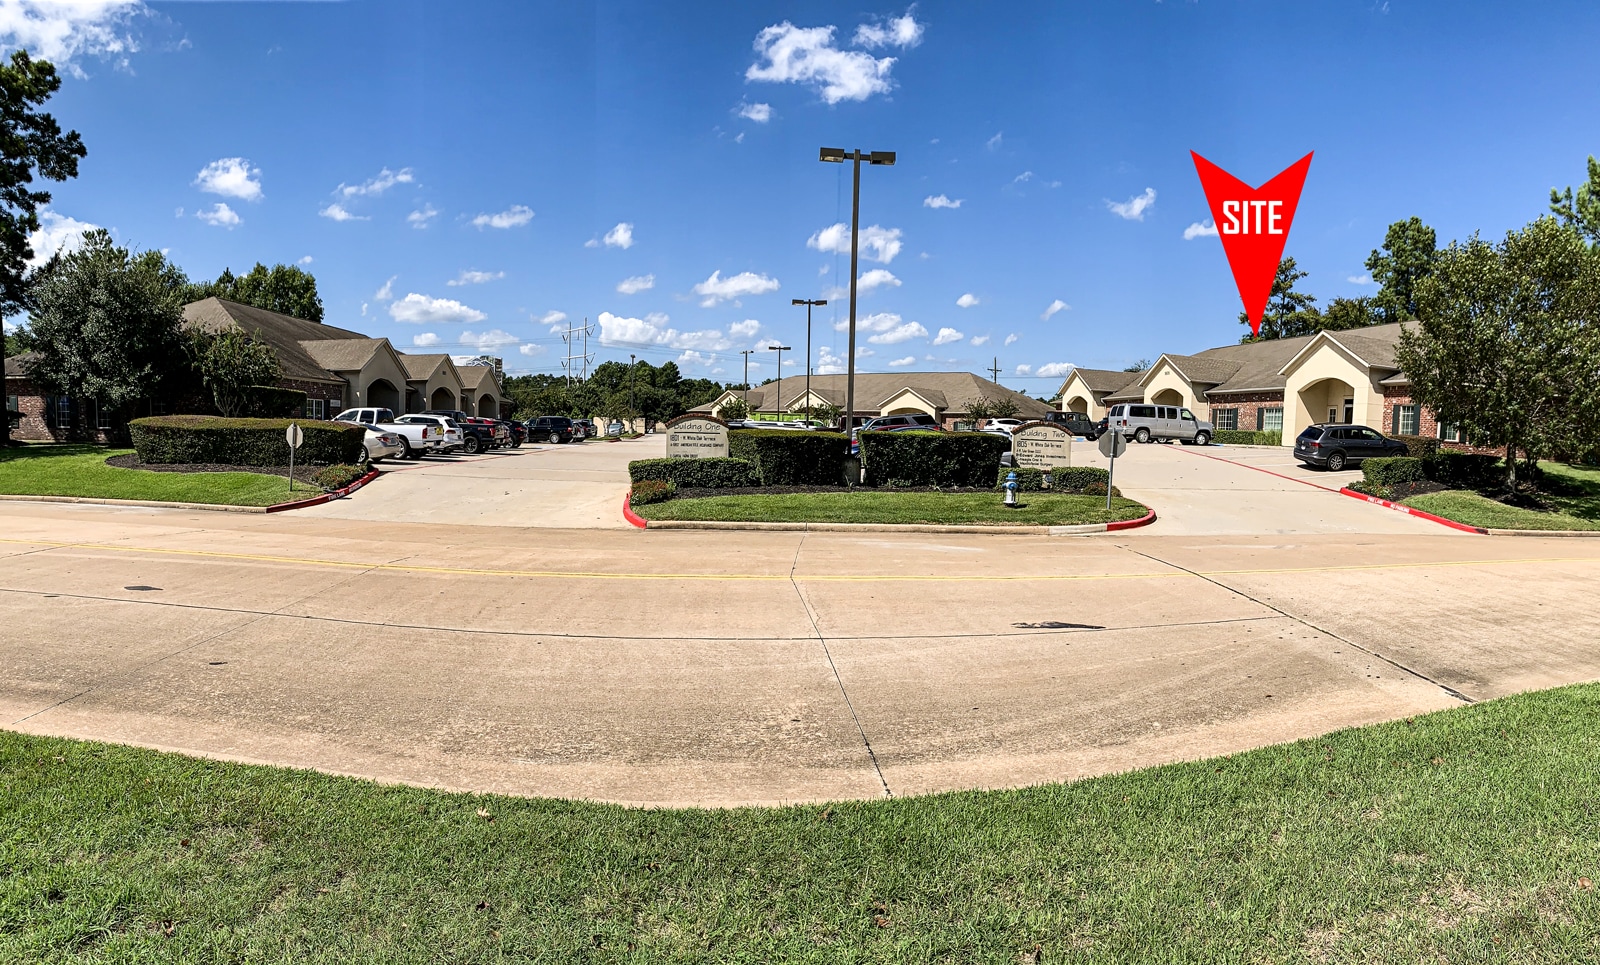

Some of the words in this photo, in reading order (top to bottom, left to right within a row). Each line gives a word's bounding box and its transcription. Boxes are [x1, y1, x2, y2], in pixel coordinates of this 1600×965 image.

[674, 423, 702, 431] Building
[705, 422, 720, 430] One
[1021, 430, 1047, 439] Building
